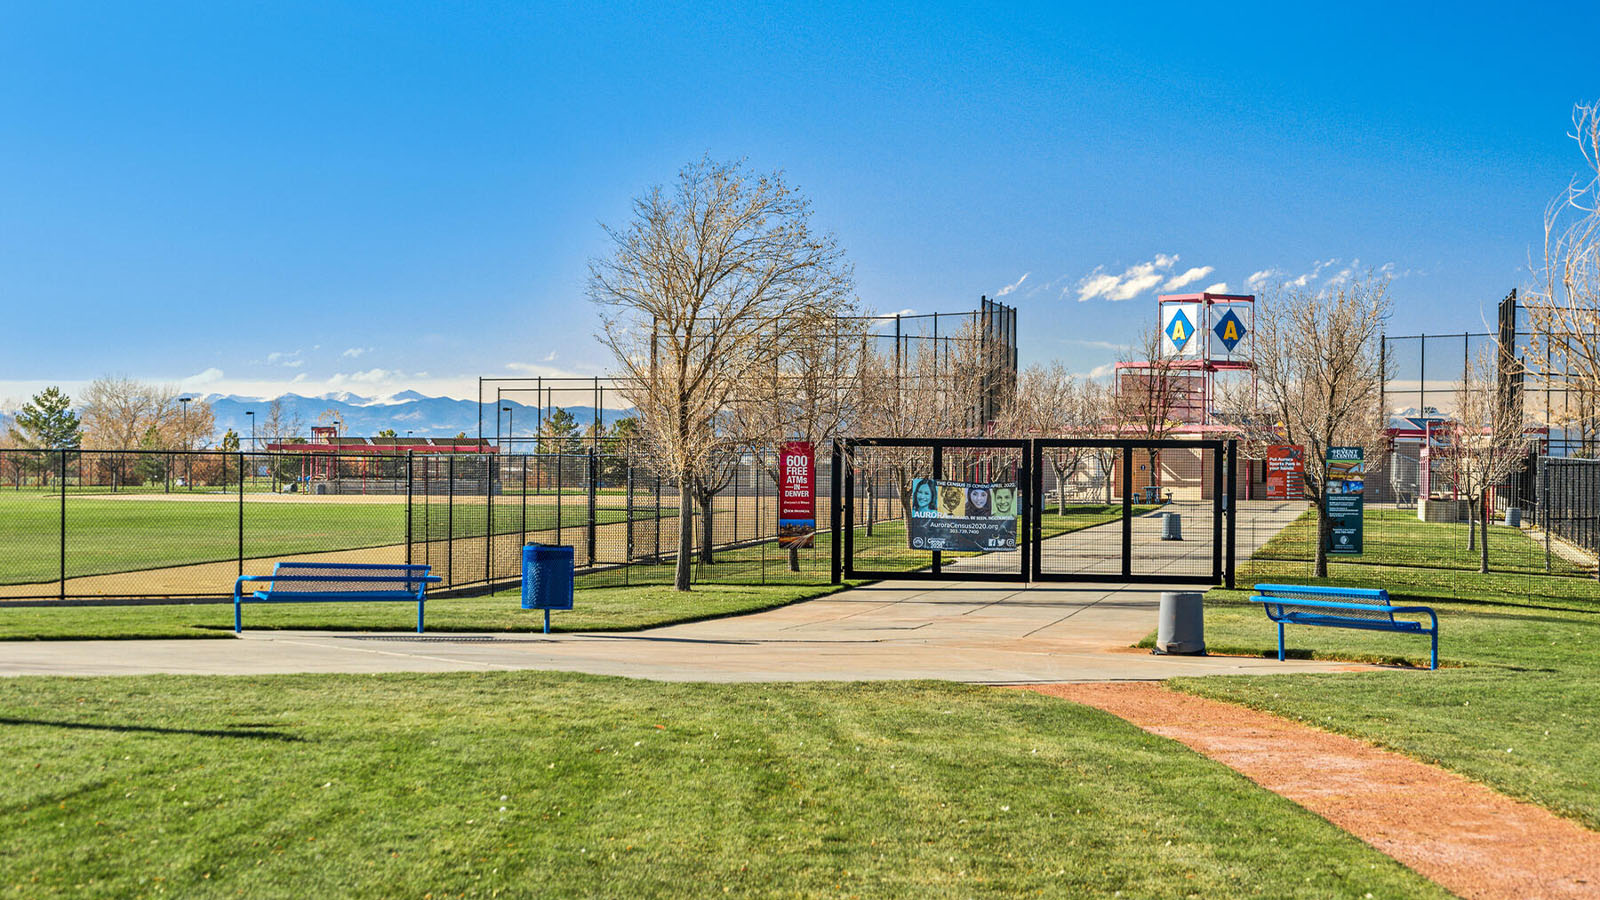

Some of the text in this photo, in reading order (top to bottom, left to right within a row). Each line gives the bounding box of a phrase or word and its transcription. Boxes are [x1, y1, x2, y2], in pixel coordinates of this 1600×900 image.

[1172, 320, 1186, 340] A
[1223, 320, 1239, 340] A
[786, 455, 808, 467] 600
[786, 466, 808, 476] FREE
[786, 476, 808, 484] ATMs
[930, 522, 998, 530] AuroraCensus2020.org
